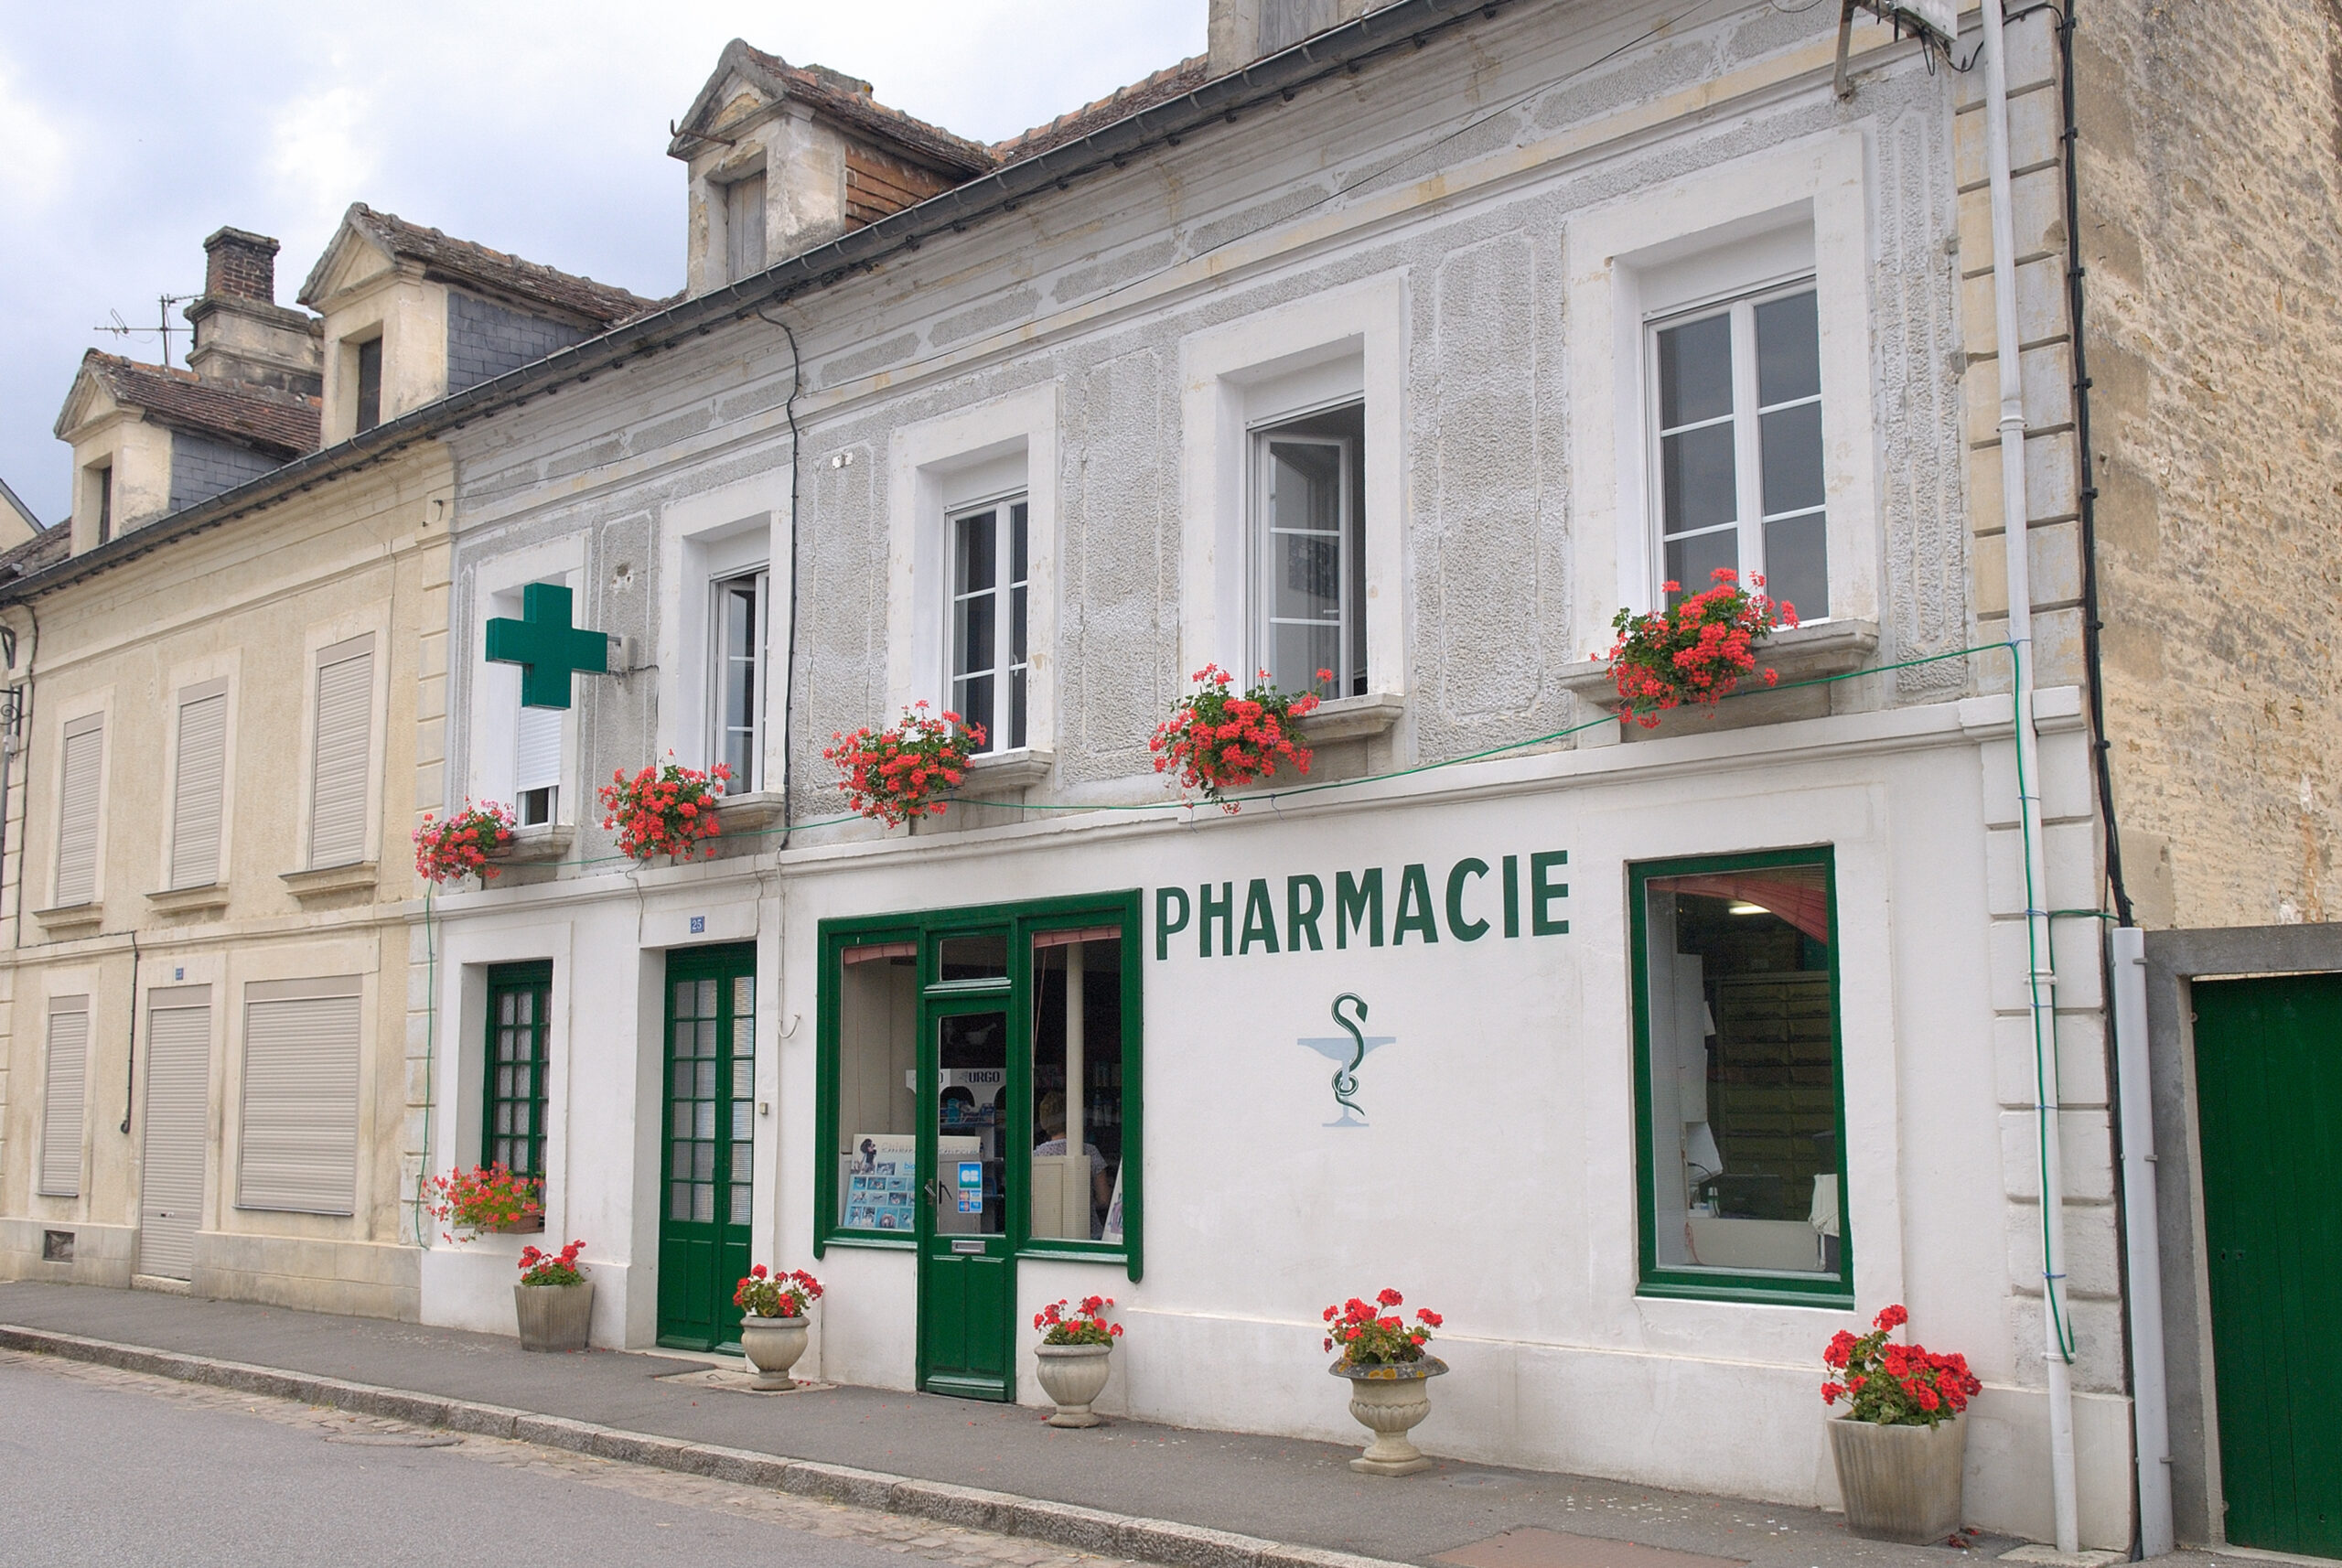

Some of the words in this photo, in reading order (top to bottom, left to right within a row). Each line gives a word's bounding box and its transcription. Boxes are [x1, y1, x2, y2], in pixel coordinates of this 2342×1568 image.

[1155, 850, 1570, 961] PHARMACIE
[692, 918, 703, 930] 25
[969, 1071, 1001, 1083] URGO
